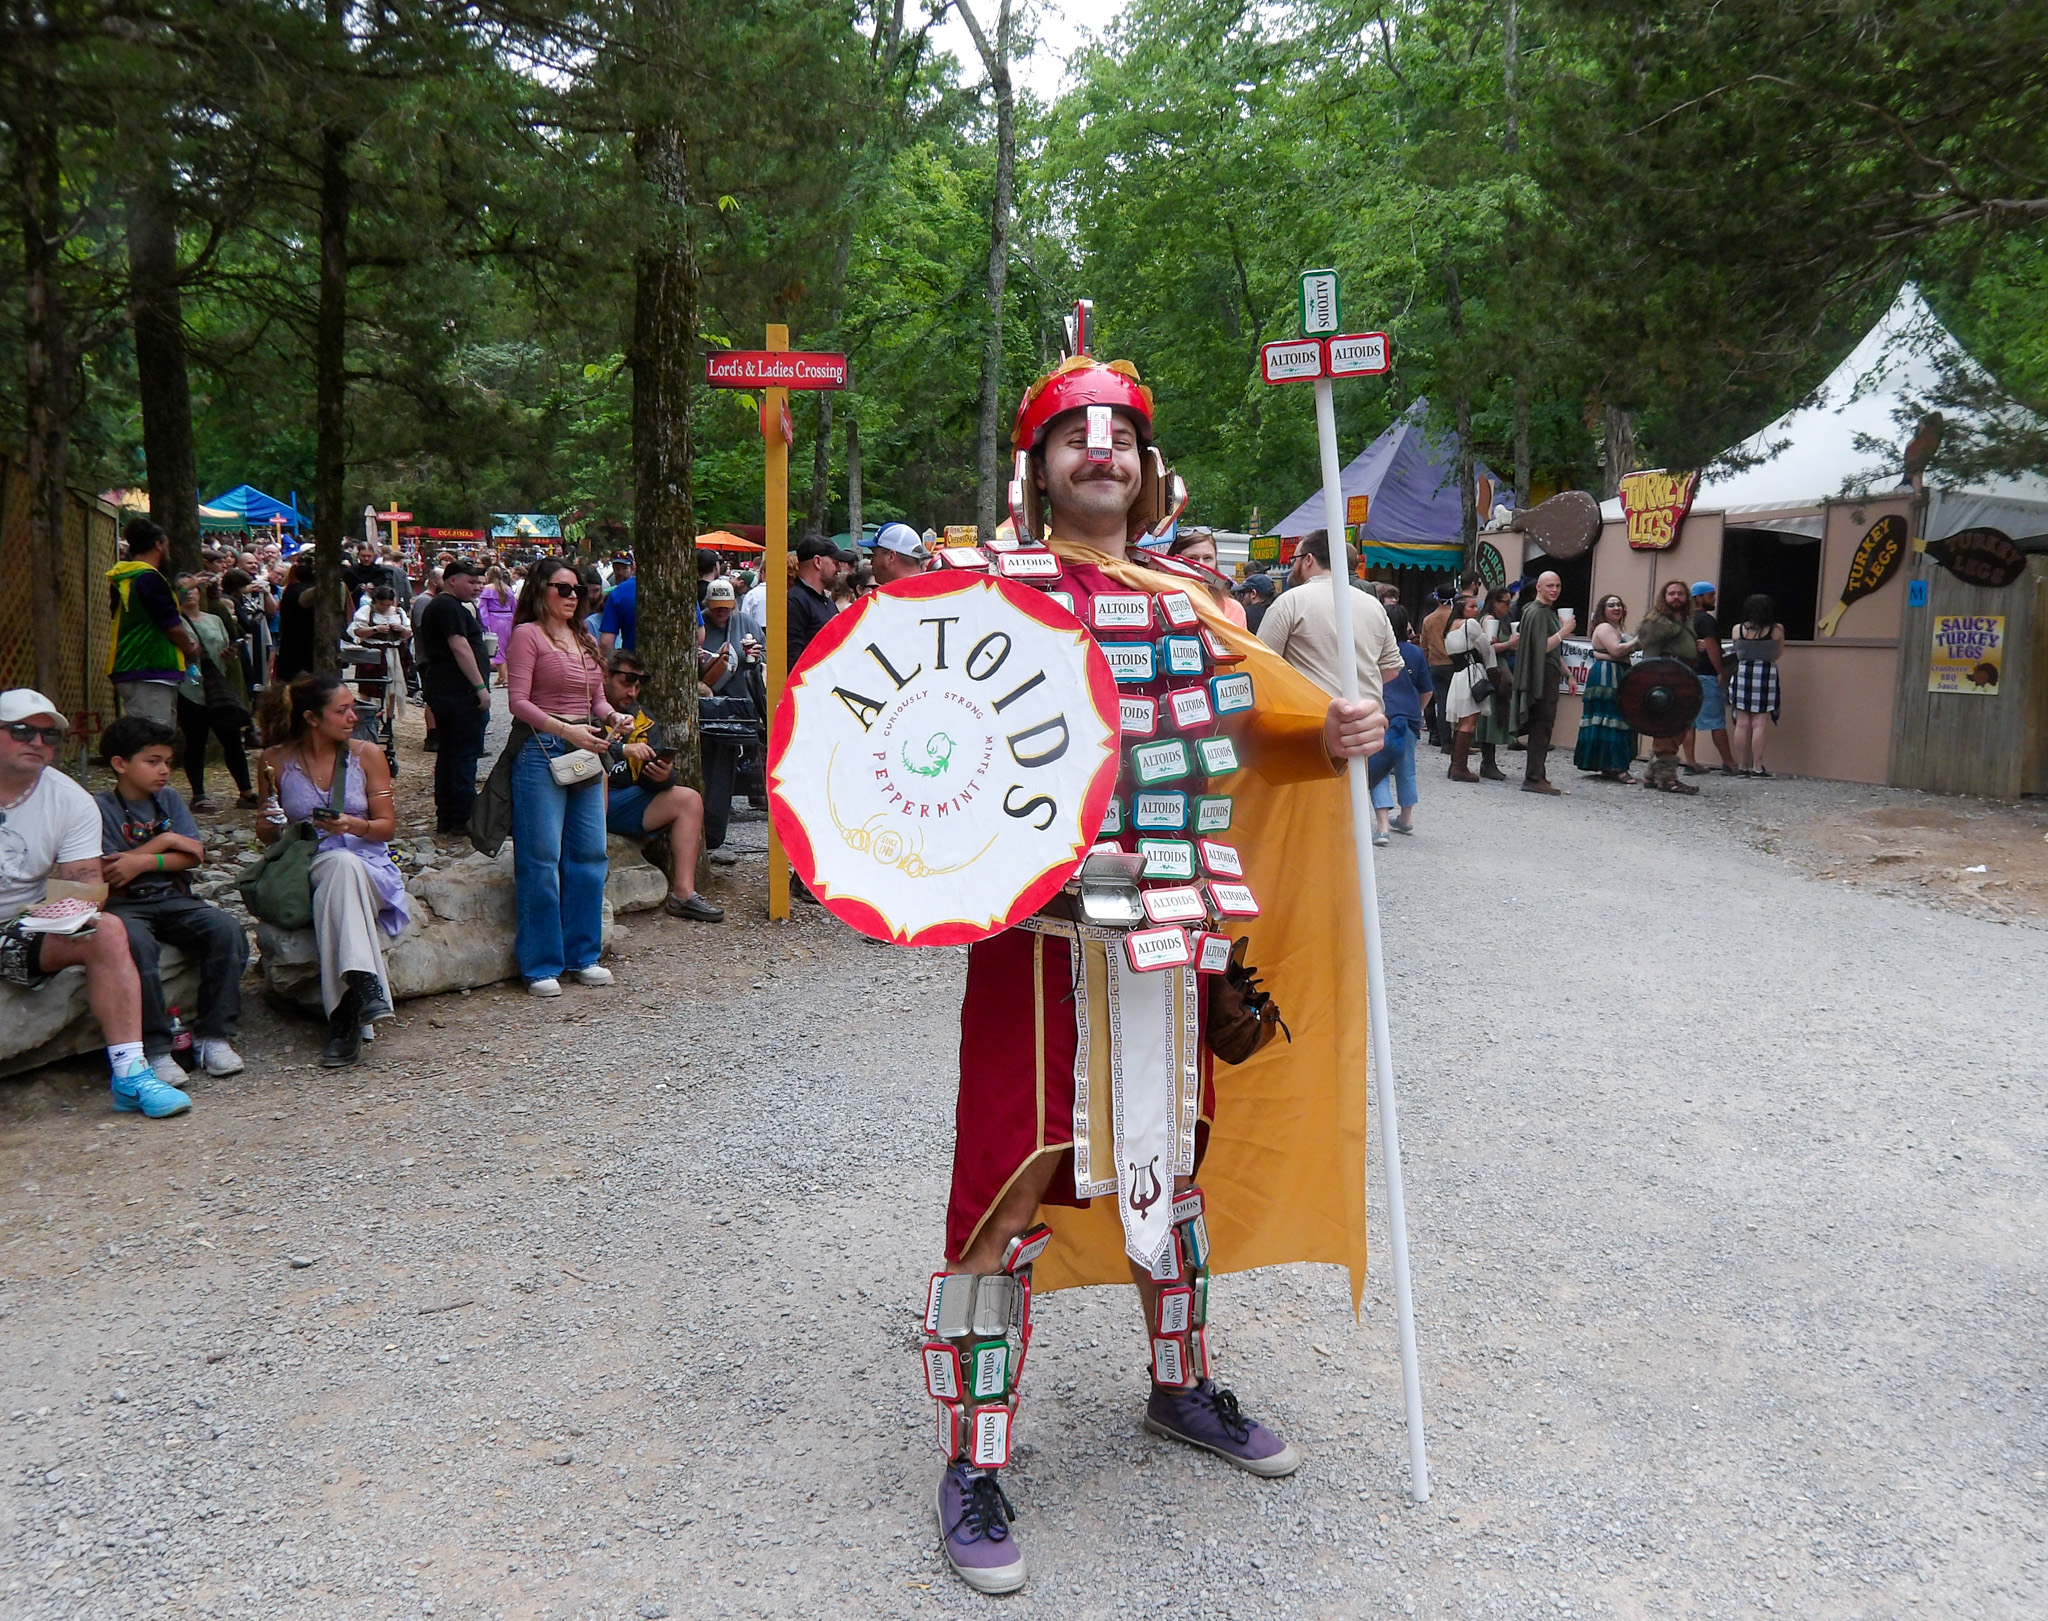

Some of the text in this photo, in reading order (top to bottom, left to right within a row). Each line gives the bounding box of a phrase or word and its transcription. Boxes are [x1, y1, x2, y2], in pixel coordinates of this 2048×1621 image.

[1316, 280, 1330, 328] ALTOIDS
[1270, 350, 1316, 367] ALTOIDS
[1334, 345, 1380, 360] ALTOIDS
[708, 359, 843, 384] Lord's & Ladies Crossing
[1629, 509, 1674, 547] LEGS
[1849, 518, 1890, 590] TURKEY
[1864, 539, 1898, 587] LEGS
[1953, 555, 2005, 584] LEGS
[1910, 587, 1923, 600] M
[1098, 603, 1145, 614] ALTOIDS
[1168, 600, 1190, 613] ALTOIDS
[1941, 617, 1997, 632] SAUCY
[1935, 632, 2000, 648] TURKEY
[1172, 647, 1198, 659] ALTOIDS
[1948, 645, 1983, 660] LEGS
[1941, 673, 1957, 682] BBQ
[1220, 683, 1249, 699] ALTOIDS
[1937, 682, 1959, 690] Sauce
[1120, 705, 1150, 720] TOIDS
[1177, 698, 1205, 714] ALTOIDS
[831, 616, 1070, 832] ALTOIDS
[884, 690, 993, 775] CURIOUSLY STRONG MINTS
[1142, 750, 1182, 768] ALTOIDS
[1207, 746, 1233, 760] ALTOIDS
[873, 751, 980, 818] PEPPERMINT
[1141, 802, 1181, 814] ALTOIDS
[1201, 805, 1228, 818] ALTOIDS
[880, 835, 899, 847] SINCE
[1146, 850, 1187, 863] ALTOIDS
[1208, 849, 1237, 864] ALTOIDS
[1153, 895, 1196, 909] ALTOIDS
[1219, 890, 1250, 902] ALTOIDS
[1137, 937, 1182, 954] ALTOIDS
[1203, 945, 1228, 958] ALTOIDS
[1172, 1200, 1198, 1215] TOIDS
[1172, 1297, 1183, 1329] ALTOIDS
[1163, 1341, 1177, 1380] ALTOIDS
[932, 1353, 947, 1394] ALTOIDS
[982, 1351, 995, 1392] ALTOIDS
[983, 1416, 996, 1460] ALTOIDS
